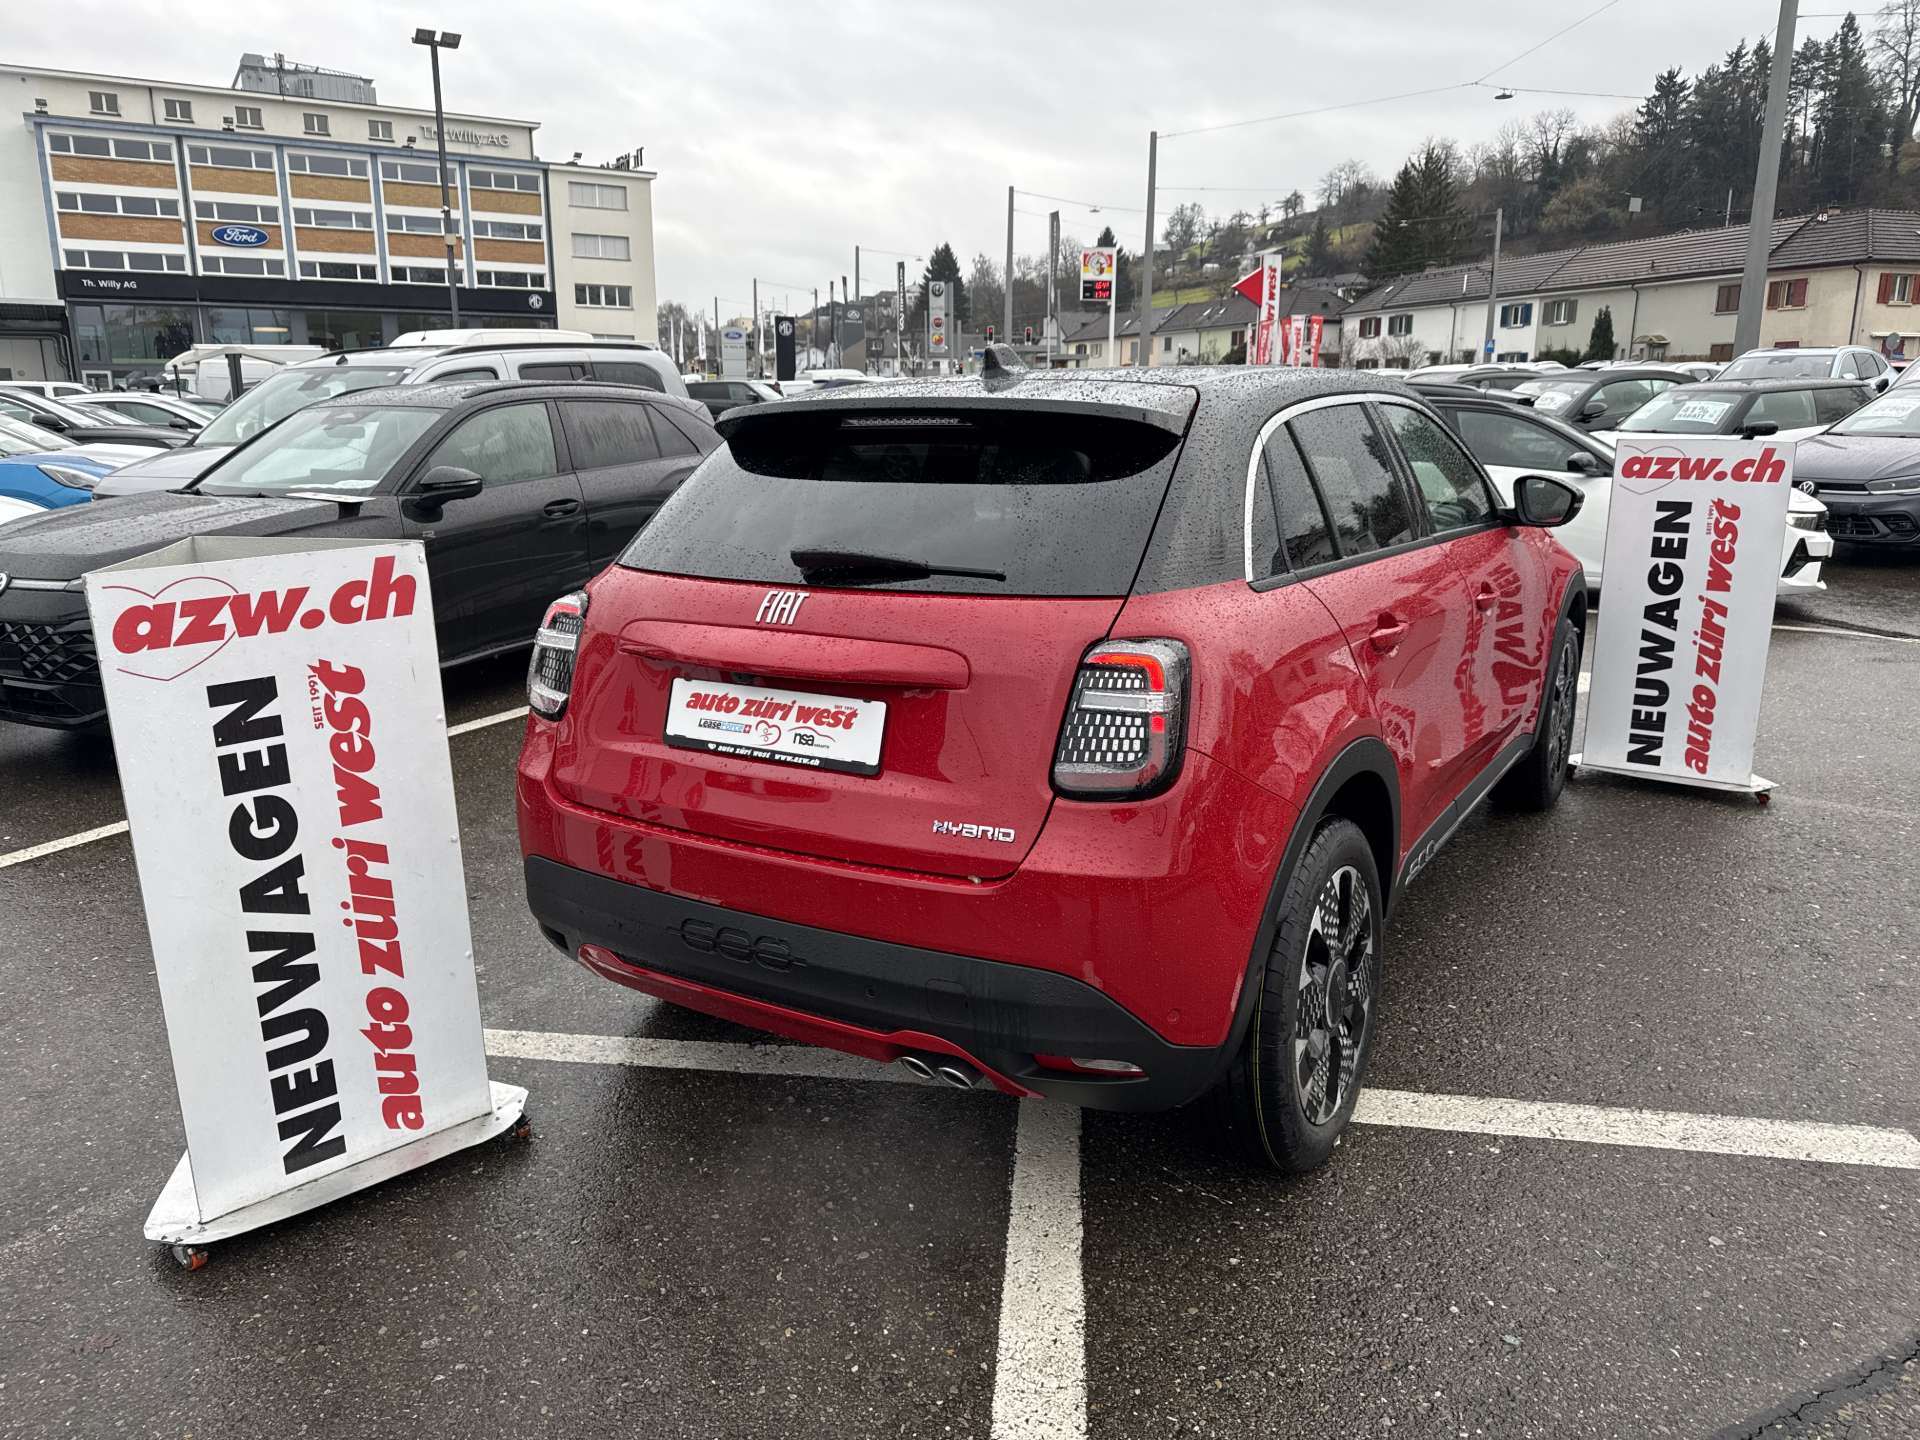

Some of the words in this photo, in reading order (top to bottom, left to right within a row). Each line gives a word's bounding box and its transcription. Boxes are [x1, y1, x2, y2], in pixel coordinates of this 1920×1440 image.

[449, 127, 483, 147] Willy
[487, 134, 511, 147] AG
[223, 227, 258, 243] Ford
[1817, 213, 1828, 222] 48
[82, 279, 96, 287] Th.
[98, 279, 121, 289] Willy
[123, 281, 137, 289] AG
[1268, 265, 1277, 301] west
[1620, 447, 1787, 484] azw.ch
[1705, 518, 1714, 535] SEIT
[1704, 497, 1743, 594] west
[112, 555, 418, 655] azw.ch
[754, 590, 810, 625] FIAT
[1627, 500, 1693, 766] NEUWAGEN
[1693, 594, 1729, 683] züri
[308, 673, 322, 700] 1991
[313, 702, 325, 730] SEIT
[686, 691, 740, 715] auto
[738, 696, 796, 722] züri
[794, 704, 859, 730] west
[306, 659, 385, 826] west
[793, 732, 815, 746] nsa
[1684, 687, 1718, 776] auto
[717, 744, 735, 754] auto
[734, 746, 751, 757] züri
[752, 749, 771, 759] west
[774, 753, 820, 767] www.azw.ch
[932, 818, 1015, 843] HYBRID
[206, 675, 347, 1176] NEUWAGEN
[331, 838, 405, 979] züri
[358, 986, 425, 1132] auto
